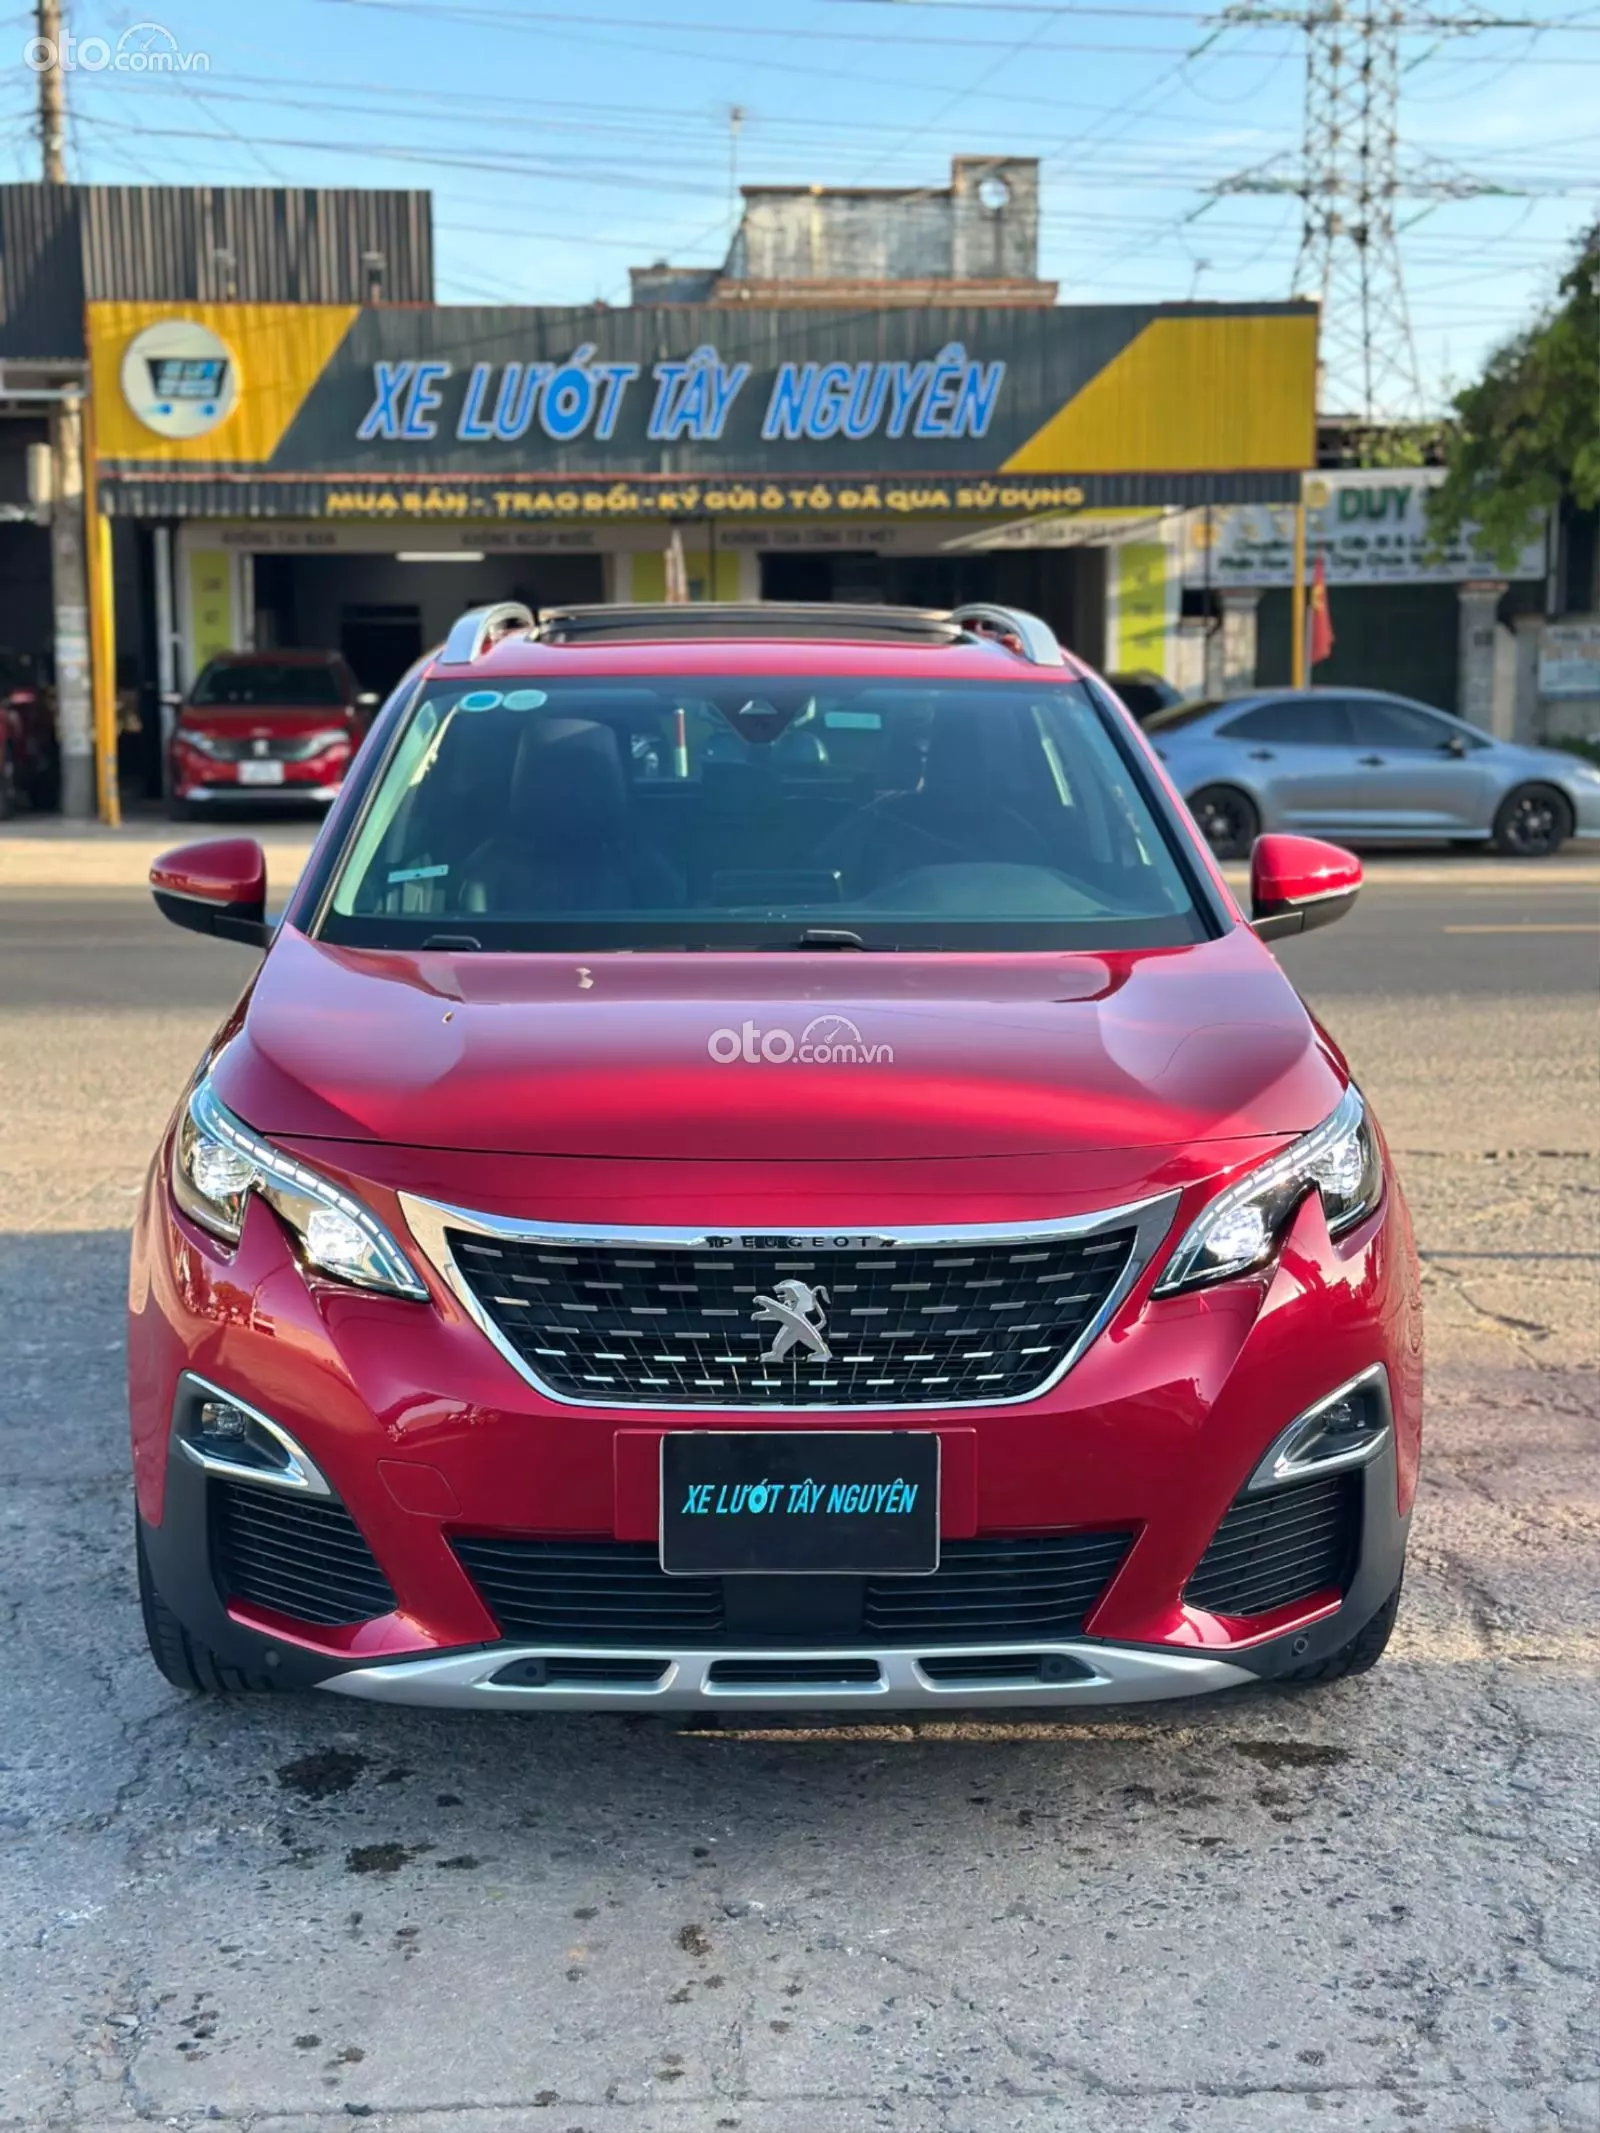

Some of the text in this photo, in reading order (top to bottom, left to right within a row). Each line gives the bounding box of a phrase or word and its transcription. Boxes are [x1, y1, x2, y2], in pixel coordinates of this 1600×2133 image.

[356, 341, 1006, 441] XE LƯỚT TÂY NGUYÊN
[326, 492, 398, 512] MUA
[402, 486, 468, 512] BÁN
[493, 491, 579, 514] TRAO
[658, 484, 699, 511] KÝ
[760, 484, 786, 511] Ô
[788, 483, 832, 511] TÔ
[885, 489, 950, 512] QUA
[1000, 486, 1084, 511] DỤNG
[1339, 485, 1412, 523] DUY
[718, 1236, 872, 1248] PEUGEOT
[681, 1477, 918, 1514] XE LƯỚT TÂY NGUYÊN
